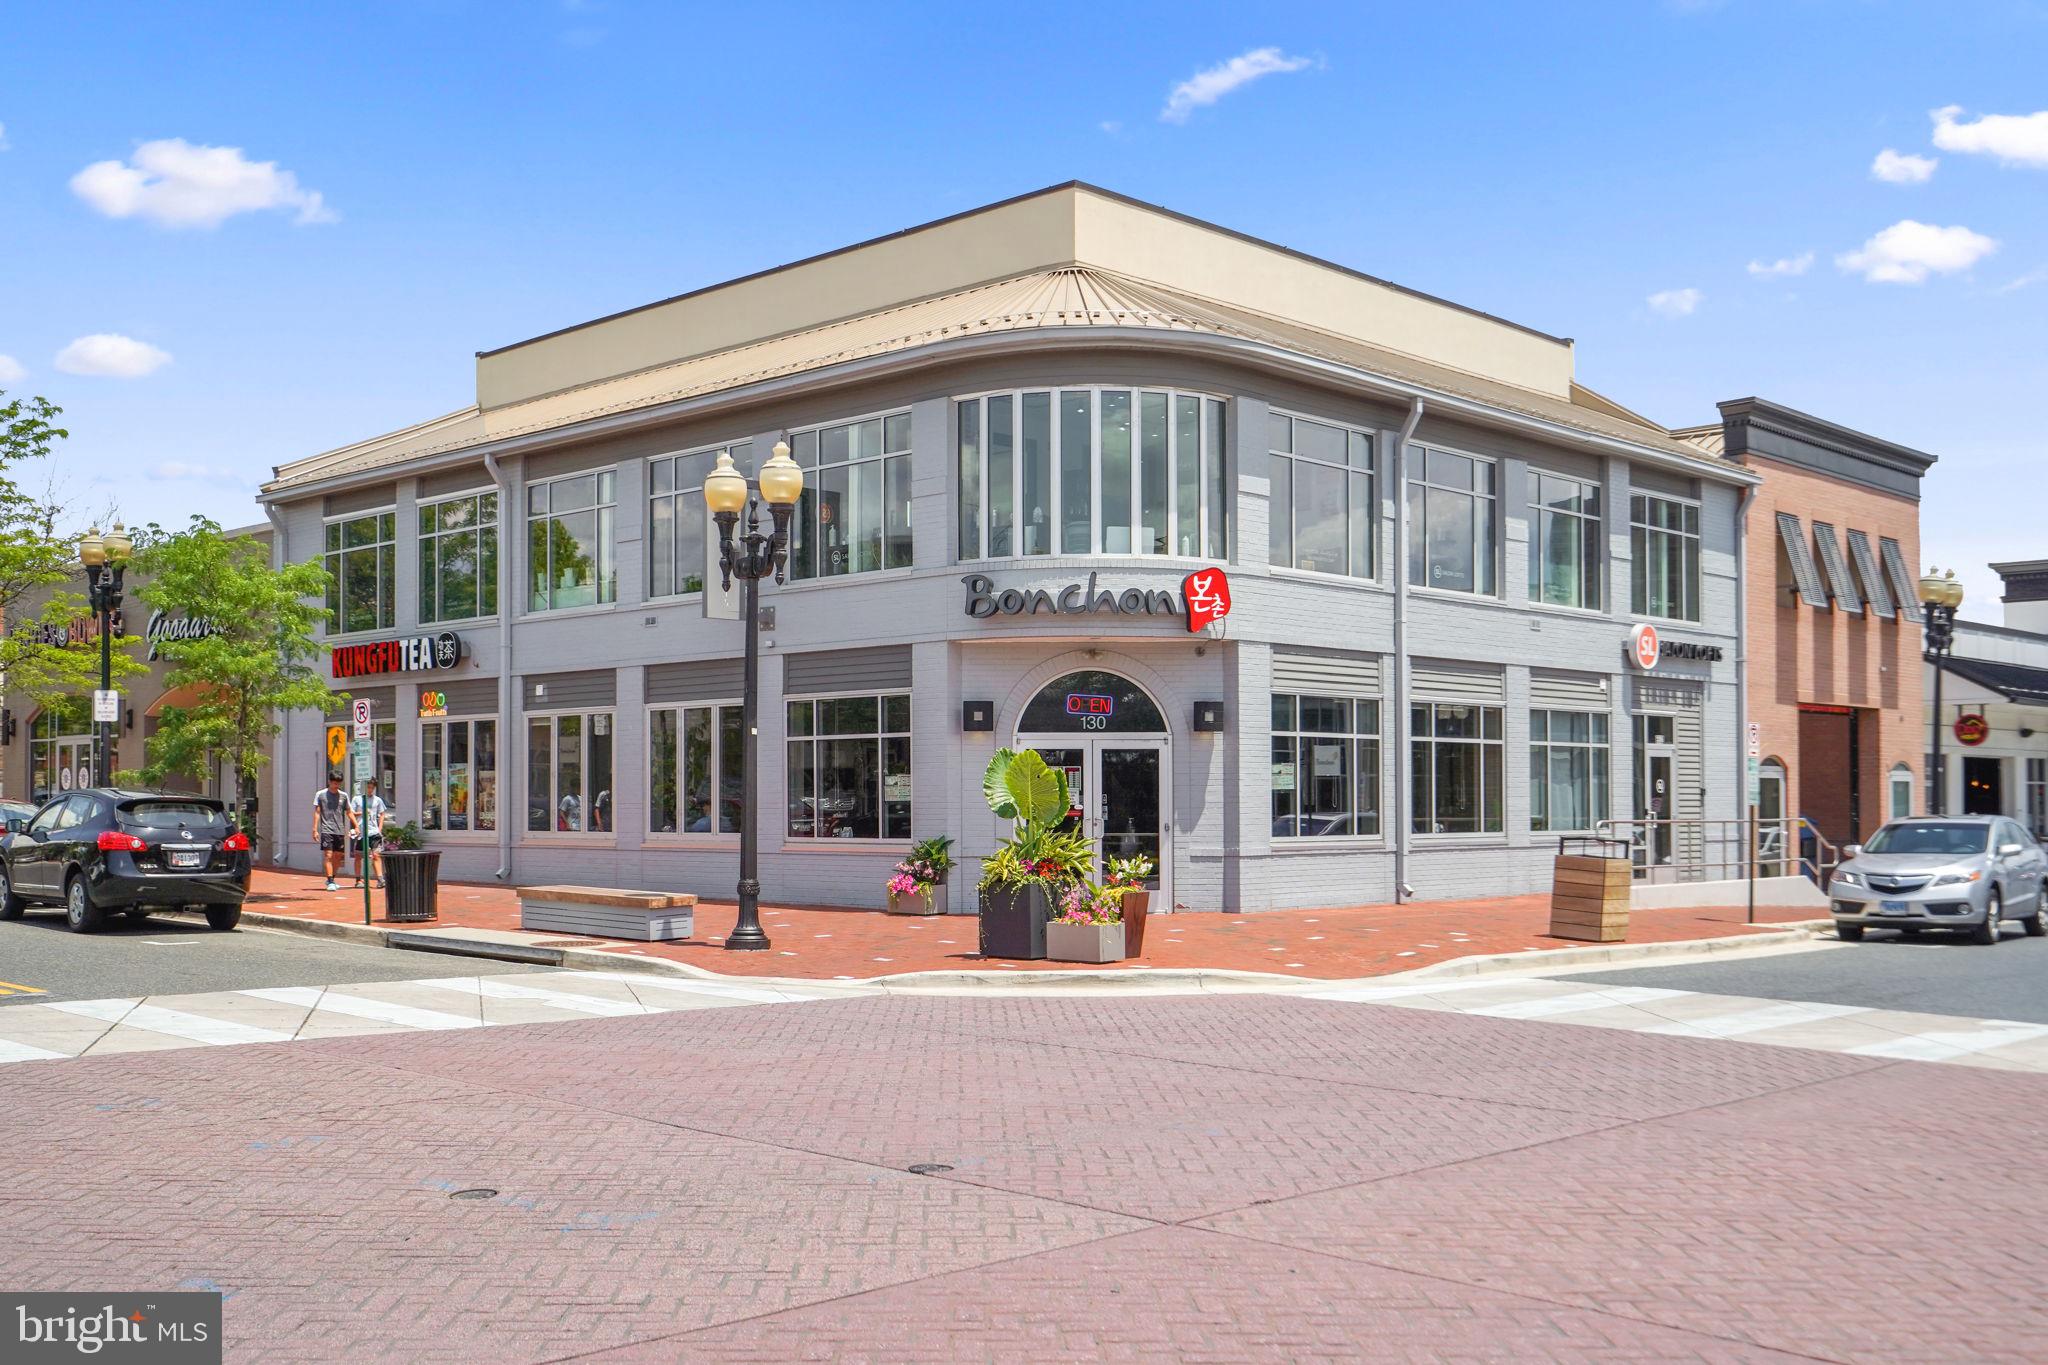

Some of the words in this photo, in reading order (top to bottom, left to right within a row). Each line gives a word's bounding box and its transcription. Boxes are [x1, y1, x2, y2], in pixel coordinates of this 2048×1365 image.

[961, 571, 1177, 618] Bonchon
[1641, 635, 1656, 656] SL
[1069, 697, 1110, 713] OPEN
[1080, 716, 1106, 729] 130
